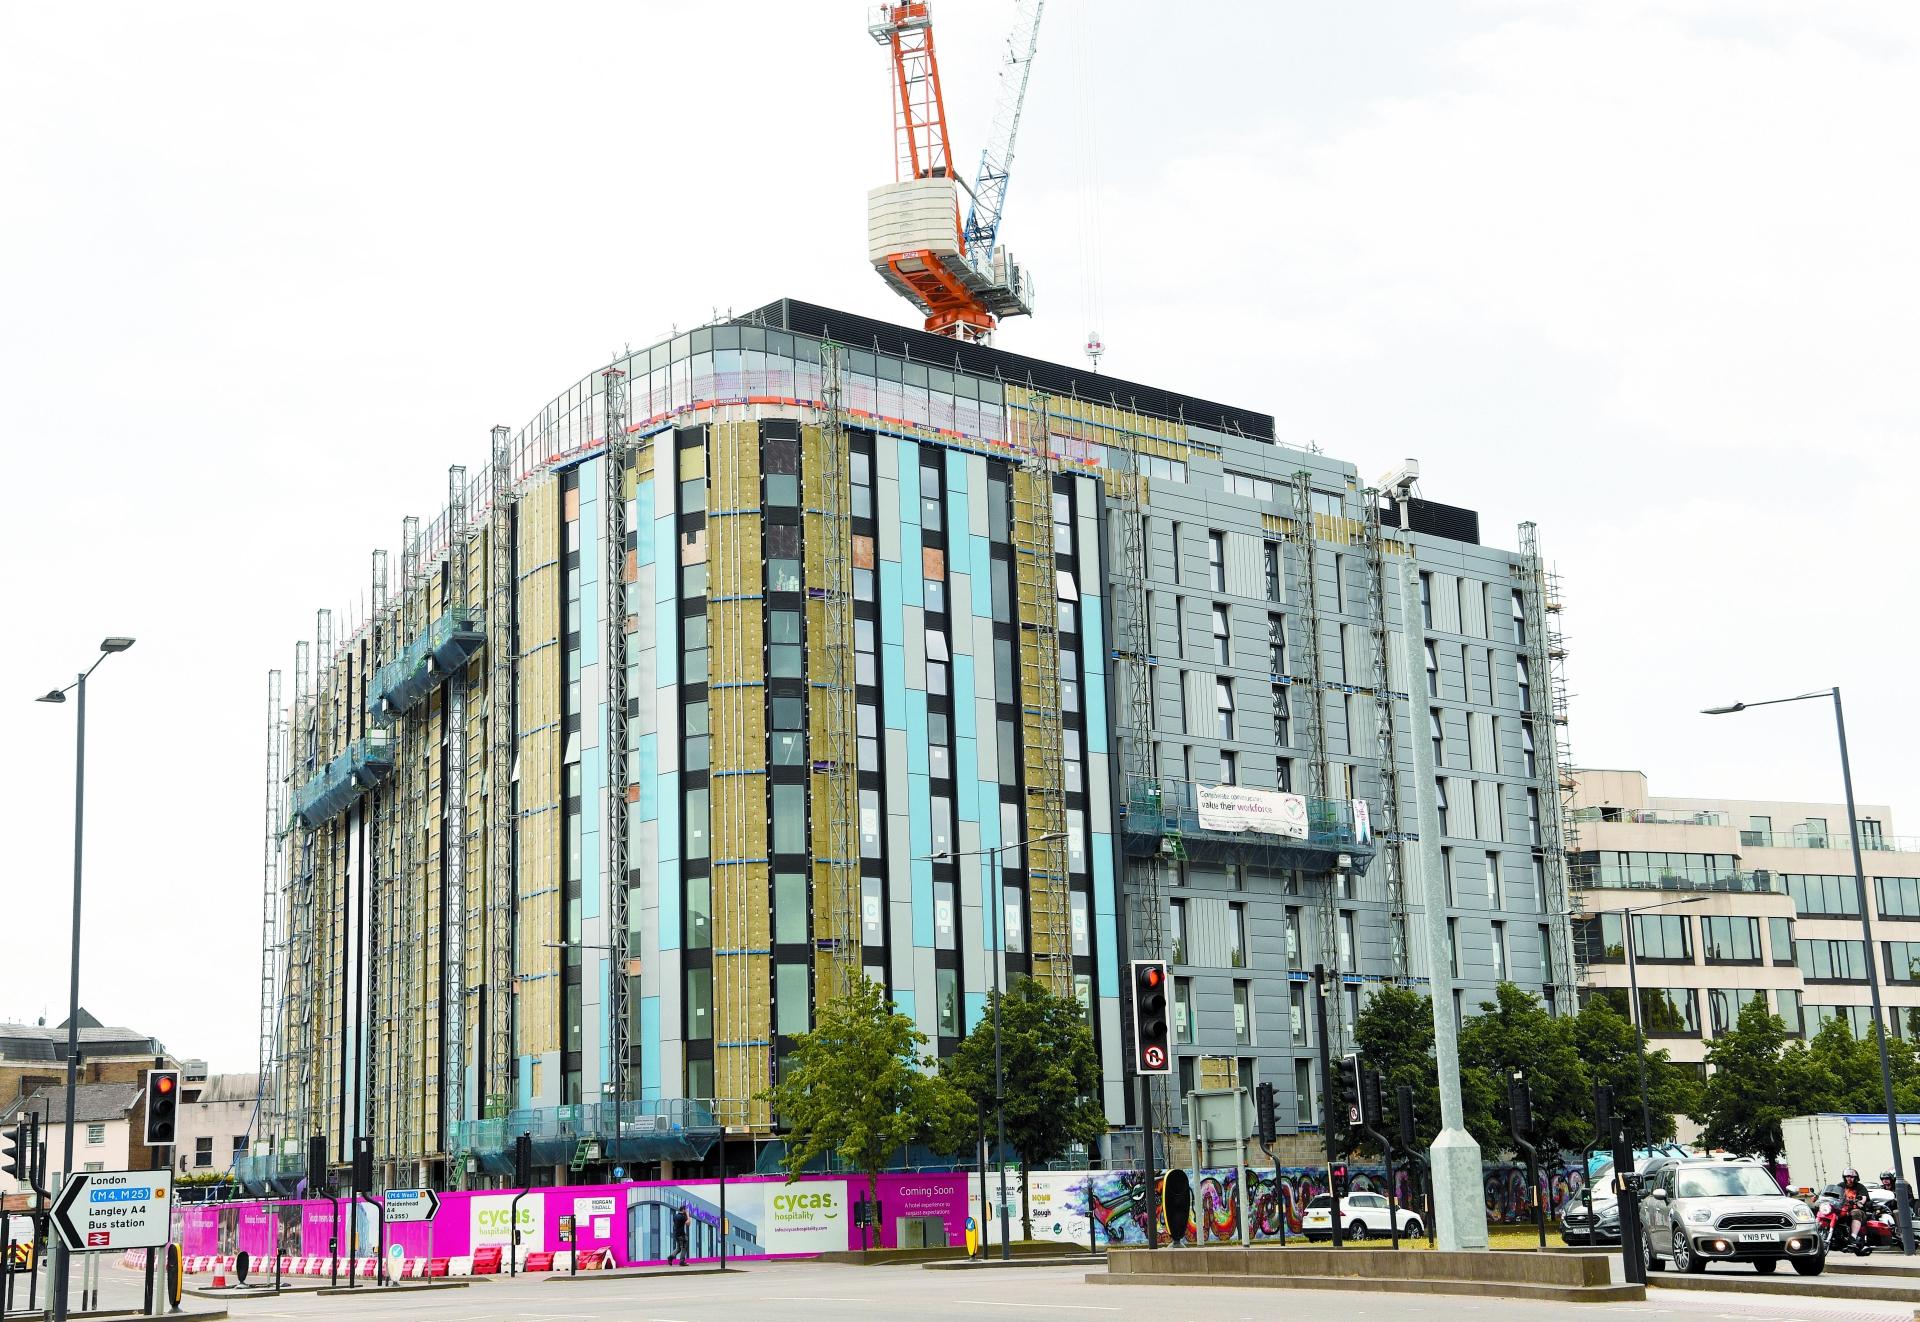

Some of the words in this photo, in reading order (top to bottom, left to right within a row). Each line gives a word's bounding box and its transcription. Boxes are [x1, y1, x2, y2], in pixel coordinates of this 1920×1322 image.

[1202, 801, 1219, 809] value
[1237, 804, 1273, 813] workforce
[90, 1176, 127, 1185] London
[900, 1186, 932, 1198] Coming
[933, 1185, 954, 1195] Soon
[89, 1206, 127, 1217] Langley
[131, 1205, 146, 1214] A4
[1032, 1209, 1051, 1217] Slough
[774, 1211, 814, 1222] hospitality
[88, 1220, 107, 1229] Bus
[110, 1219, 145, 1228] station
[1742, 1233, 1760, 1241] YN19
[1760, 1233, 1775, 1241] PVL
